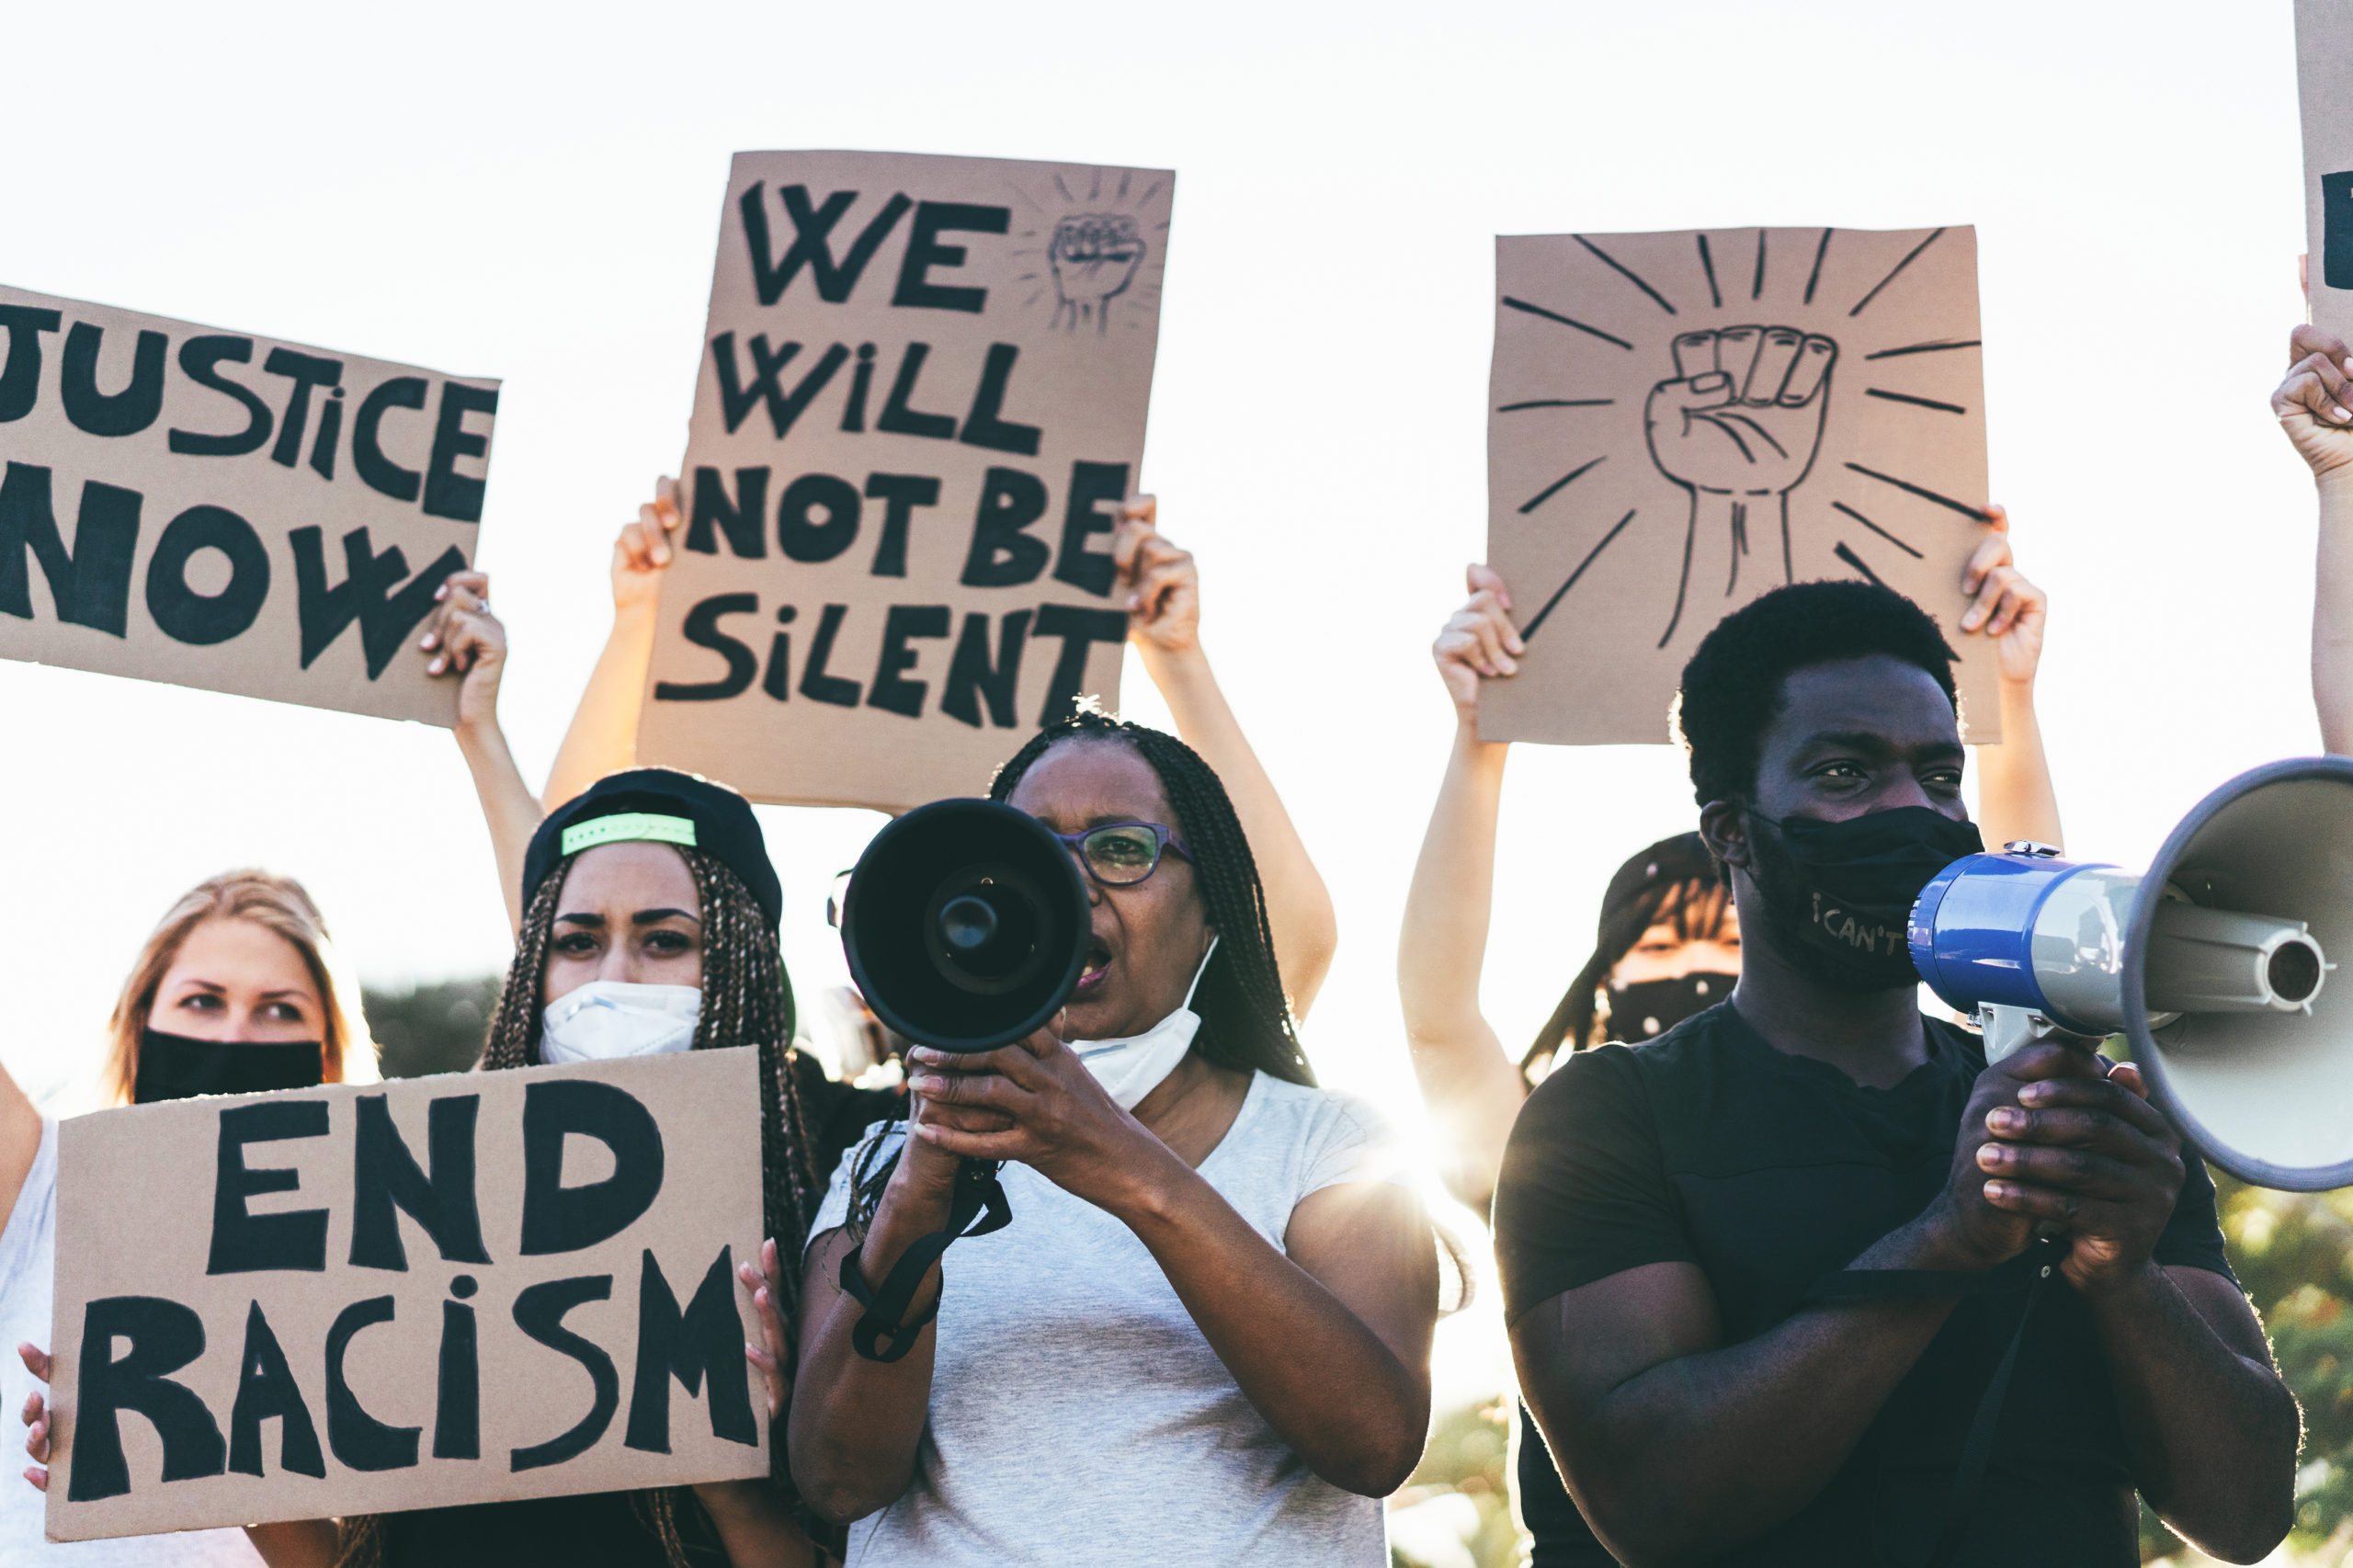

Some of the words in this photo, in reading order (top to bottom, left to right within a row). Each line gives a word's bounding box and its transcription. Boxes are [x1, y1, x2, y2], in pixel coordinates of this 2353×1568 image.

[739, 180, 1012, 314] WE
[0, 460, 469, 682] NOW
[685, 465, 942, 579] NOT
[960, 460, 1131, 599] BE
[1824, 908, 1904, 956] CAN'T
[206, 1079, 665, 1275] END
